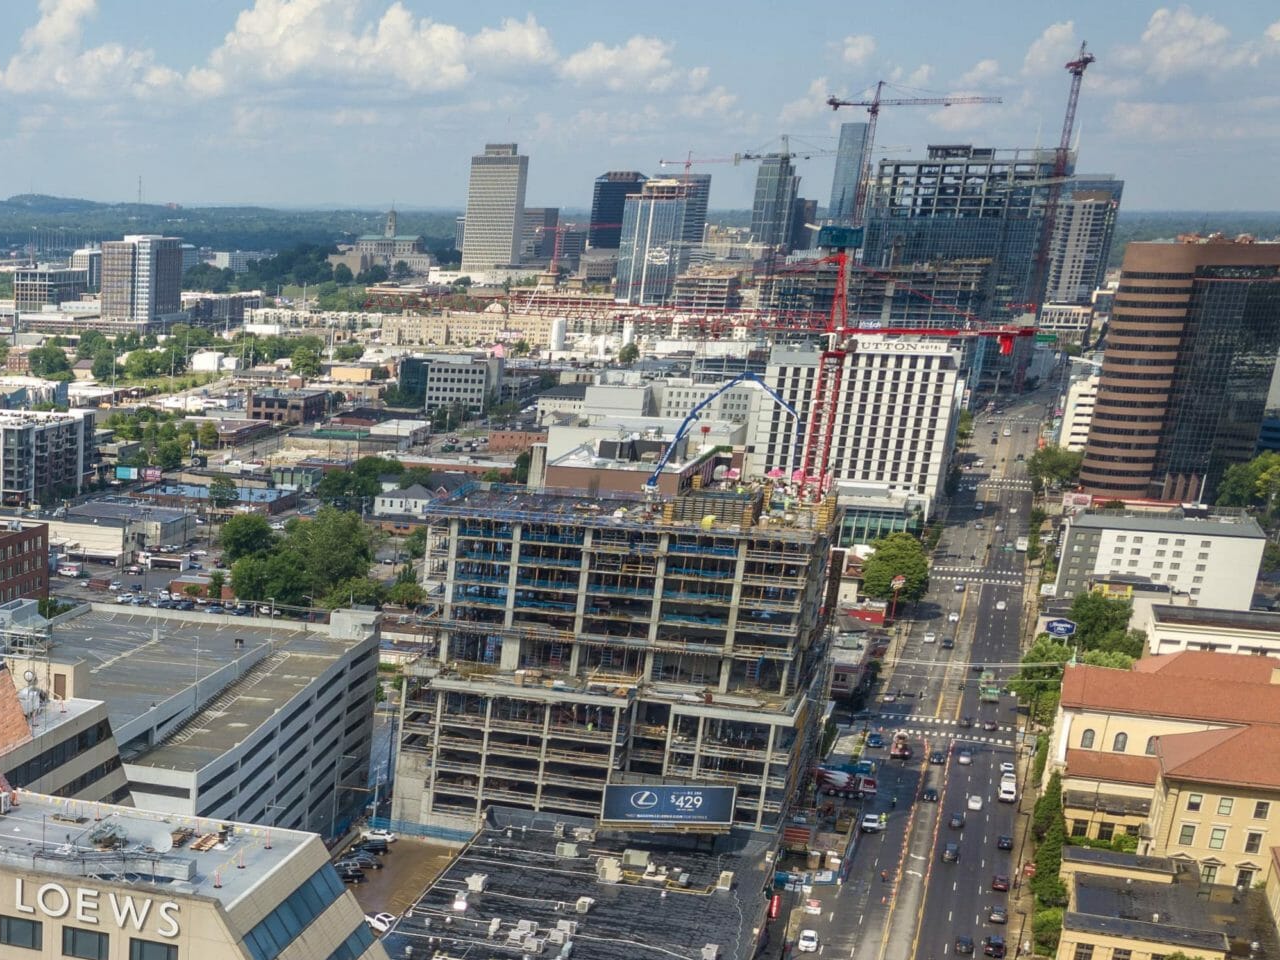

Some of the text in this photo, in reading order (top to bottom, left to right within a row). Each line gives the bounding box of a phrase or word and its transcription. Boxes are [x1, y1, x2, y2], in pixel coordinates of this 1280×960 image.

[861, 342, 919, 351] UTTON
[670, 794, 703, 809] $429
[16, 878, 181, 938] LOEWS
